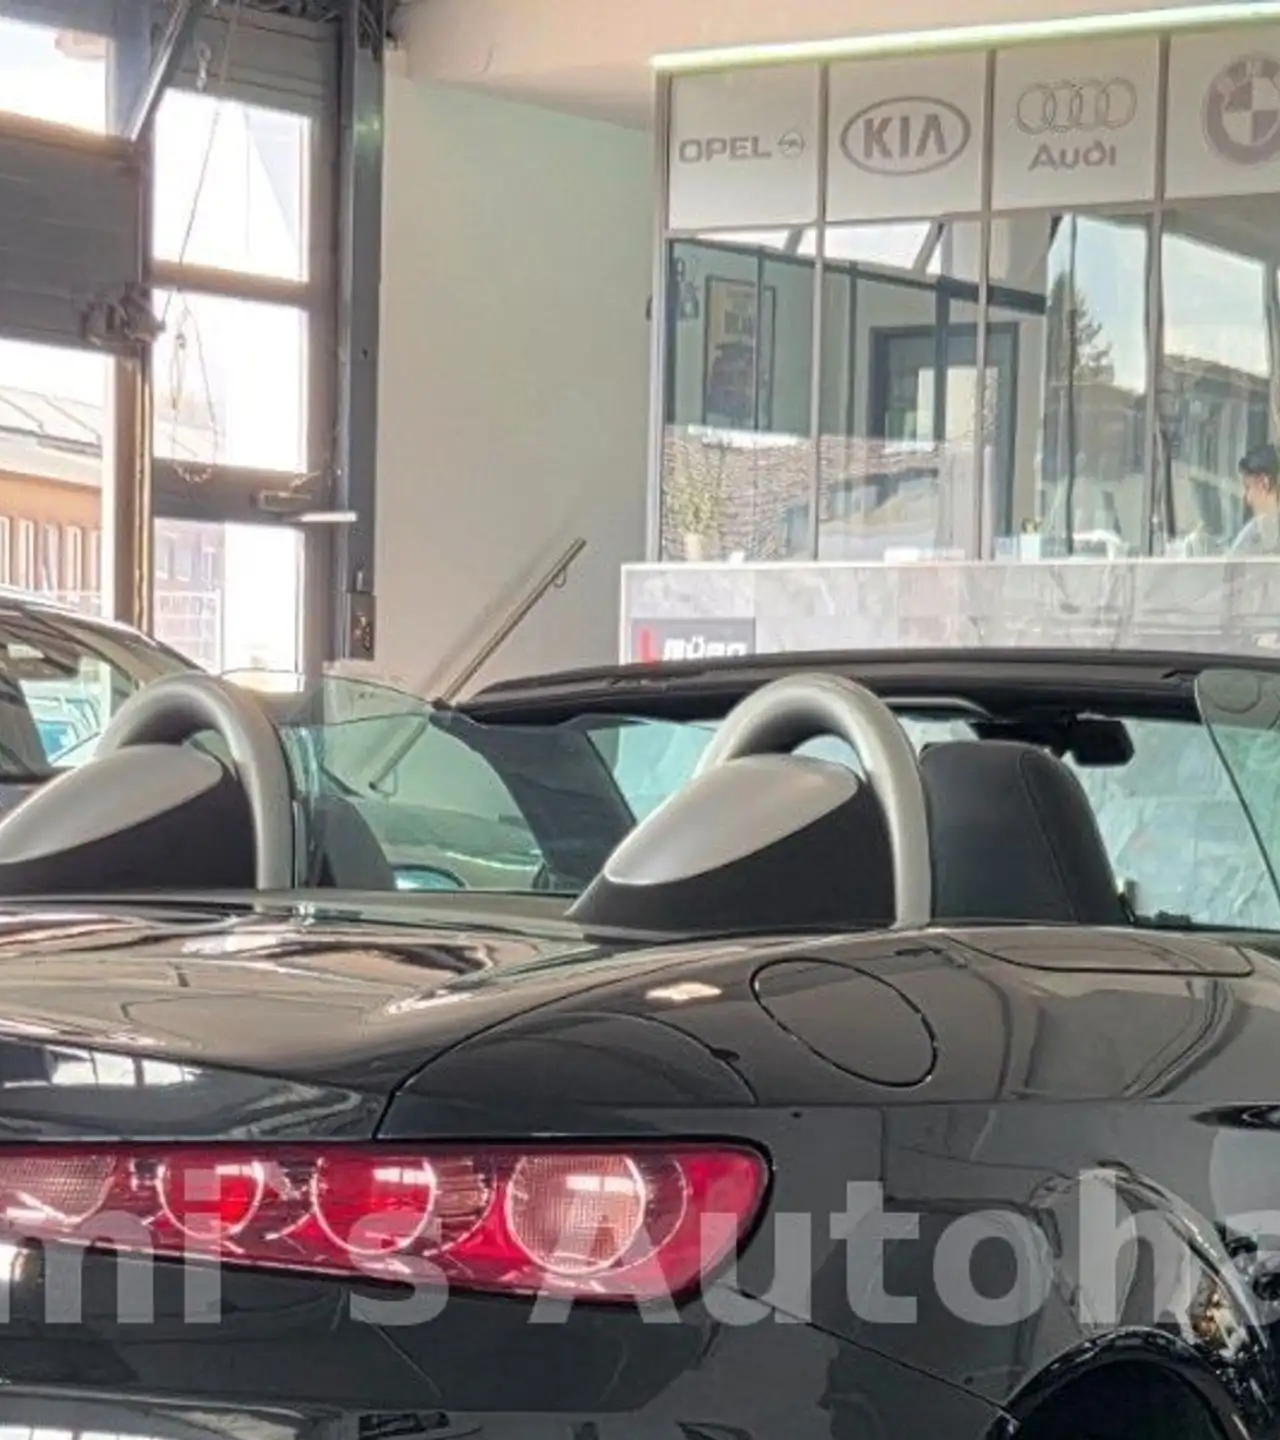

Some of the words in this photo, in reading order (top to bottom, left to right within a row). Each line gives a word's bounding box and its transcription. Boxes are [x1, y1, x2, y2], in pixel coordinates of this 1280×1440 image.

[678, 135, 772, 163] OPEL
[862, 112, 946, 159] KIA
[1027, 140, 1117, 172] Audi
